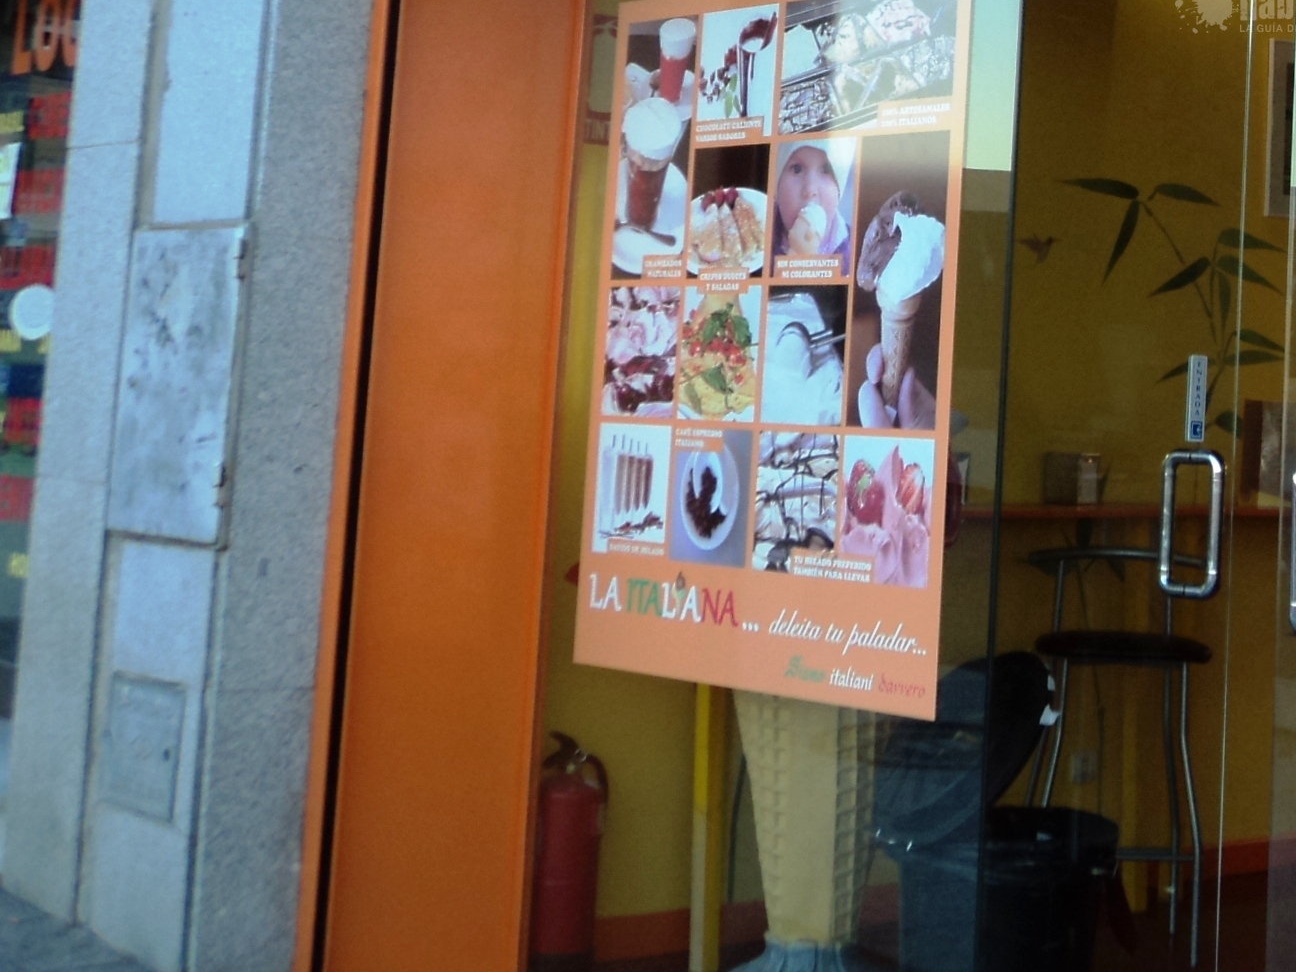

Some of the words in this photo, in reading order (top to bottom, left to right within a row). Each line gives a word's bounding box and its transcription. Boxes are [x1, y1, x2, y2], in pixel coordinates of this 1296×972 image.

[589, 572, 622, 612] LA
[768, 608, 823, 641] deleita
[824, 622, 845, 644] tu
[828, 666, 875, 691] italiani
